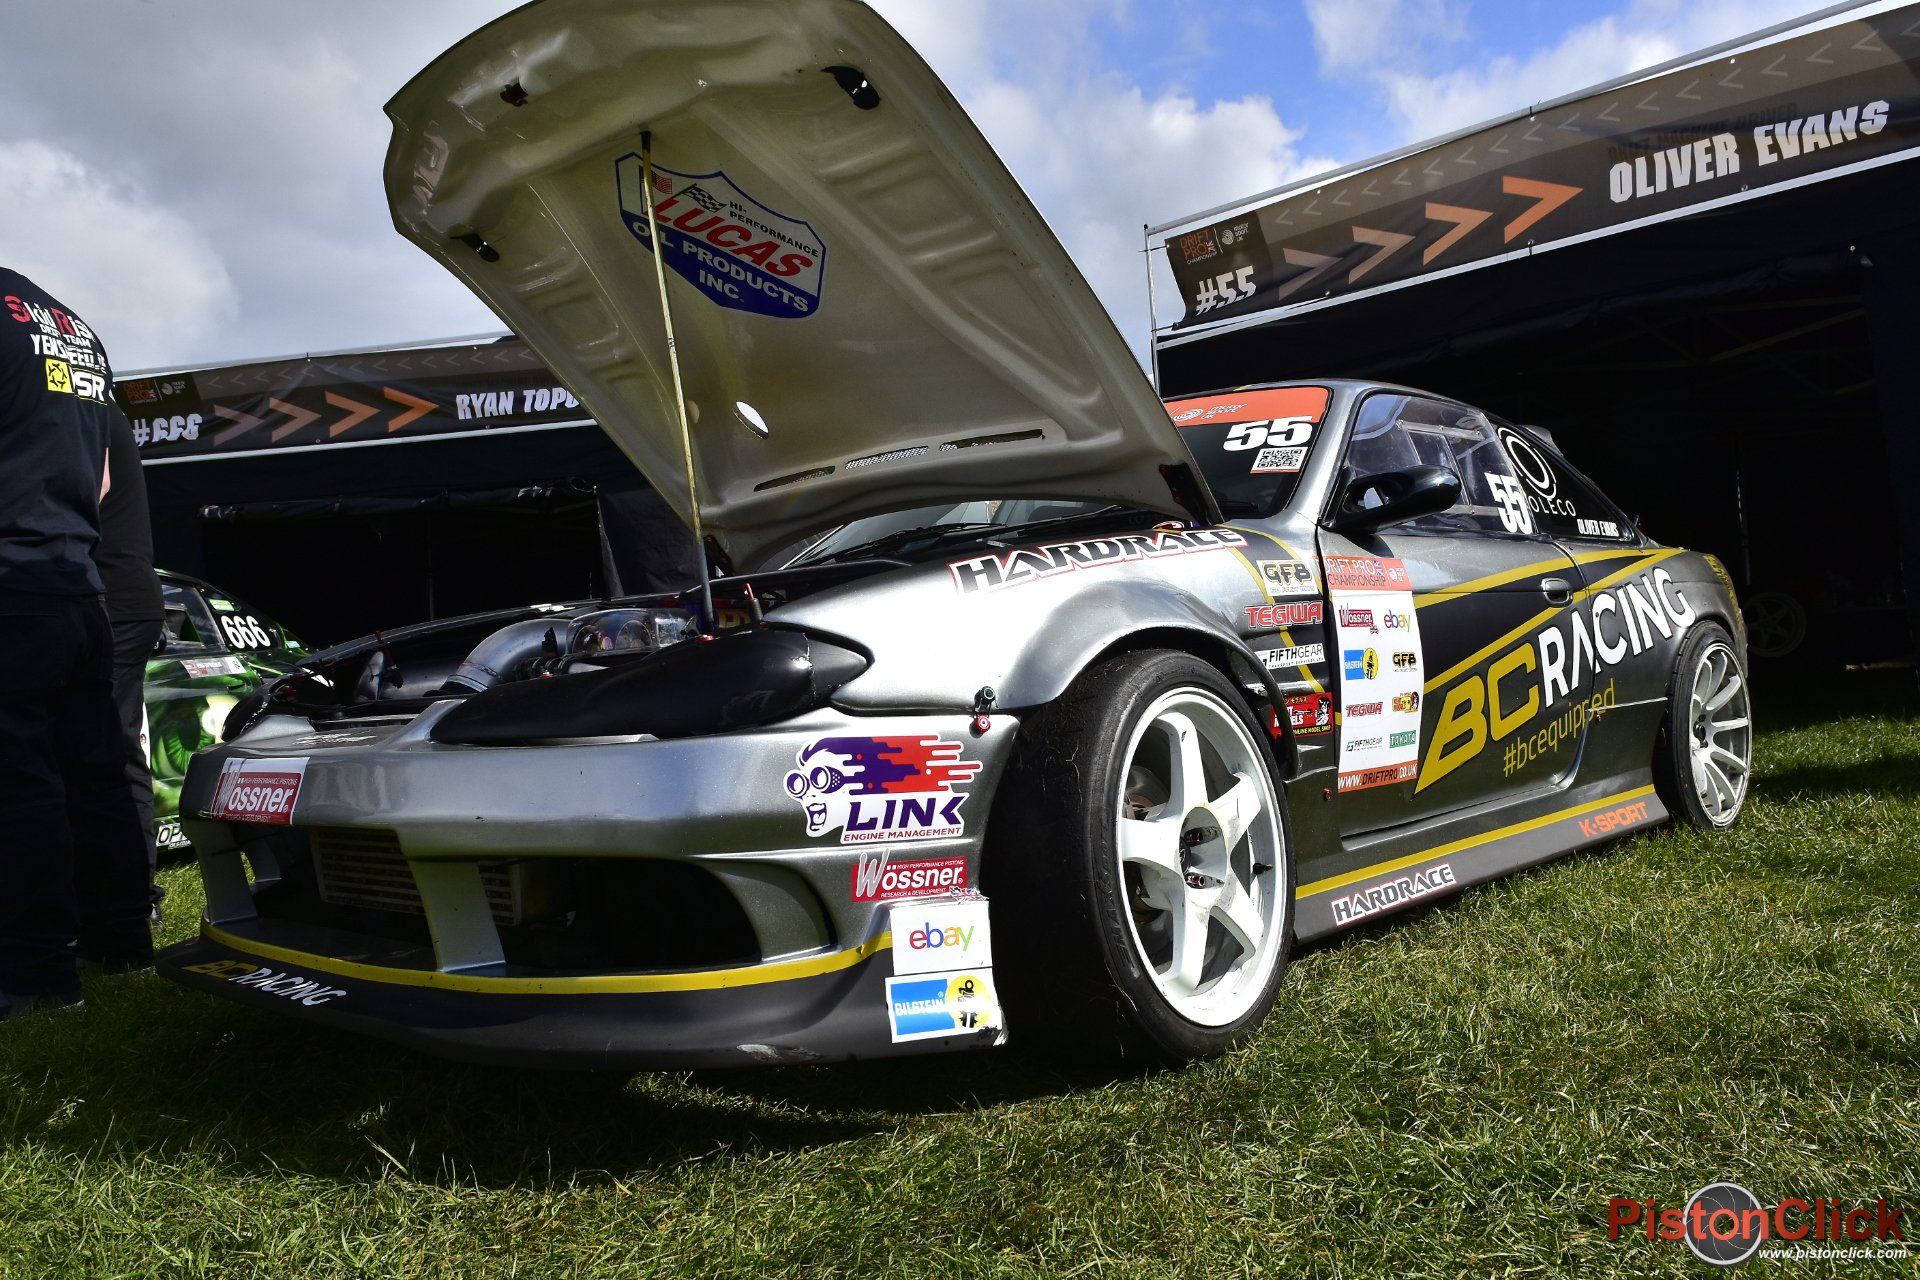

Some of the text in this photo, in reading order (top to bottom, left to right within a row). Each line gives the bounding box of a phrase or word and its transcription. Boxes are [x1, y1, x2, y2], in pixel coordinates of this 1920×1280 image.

[1610, 100, 1889, 203] OLIVER EVANS
[642, 198, 813, 276] LUCAS
[729, 211, 819, 258] PERFORMANCE
[632, 221, 809, 312] OL PRODUCTS
[699, 269, 744, 302] INC.
[1195, 265, 1257, 316] #55
[455, 390, 515, 420] RYAN
[1223, 416, 1313, 452] 55
[1484, 472, 1533, 534] 55
[1528, 495, 1577, 517] OLECO
[1576, 518, 1600, 535] OLIVER
[954, 529, 1244, 594] HARDRACE
[1263, 562, 1312, 586] GFB
[1351, 559, 1376, 575] PRO
[1327, 573, 1386, 586] CHAMPIONSHIP
[1244, 601, 1324, 630] TEGIWA
[1383, 609, 1411, 633] ebay
[220, 615, 271, 649] 666
[1269, 644, 1323, 663] FIFTHGEAR
[1392, 652, 1417, 668] GFB
[1346, 702, 1384, 717] TEGIWA
[1390, 732, 1416, 747] TAKATA
[845, 796, 967, 831] LINK
[843, 827, 962, 842] ENGINE MANAGEMENT
[909, 861, 945, 869] PERFORMANCE
[944, 859, 964, 867] PISTONS
[911, 888, 947, 896] DEVELOPMENT
[1332, 865, 1455, 924] HARDRACE
[909, 922, 975, 951] ebay
[894, 997, 945, 1017] BILSTEIN
